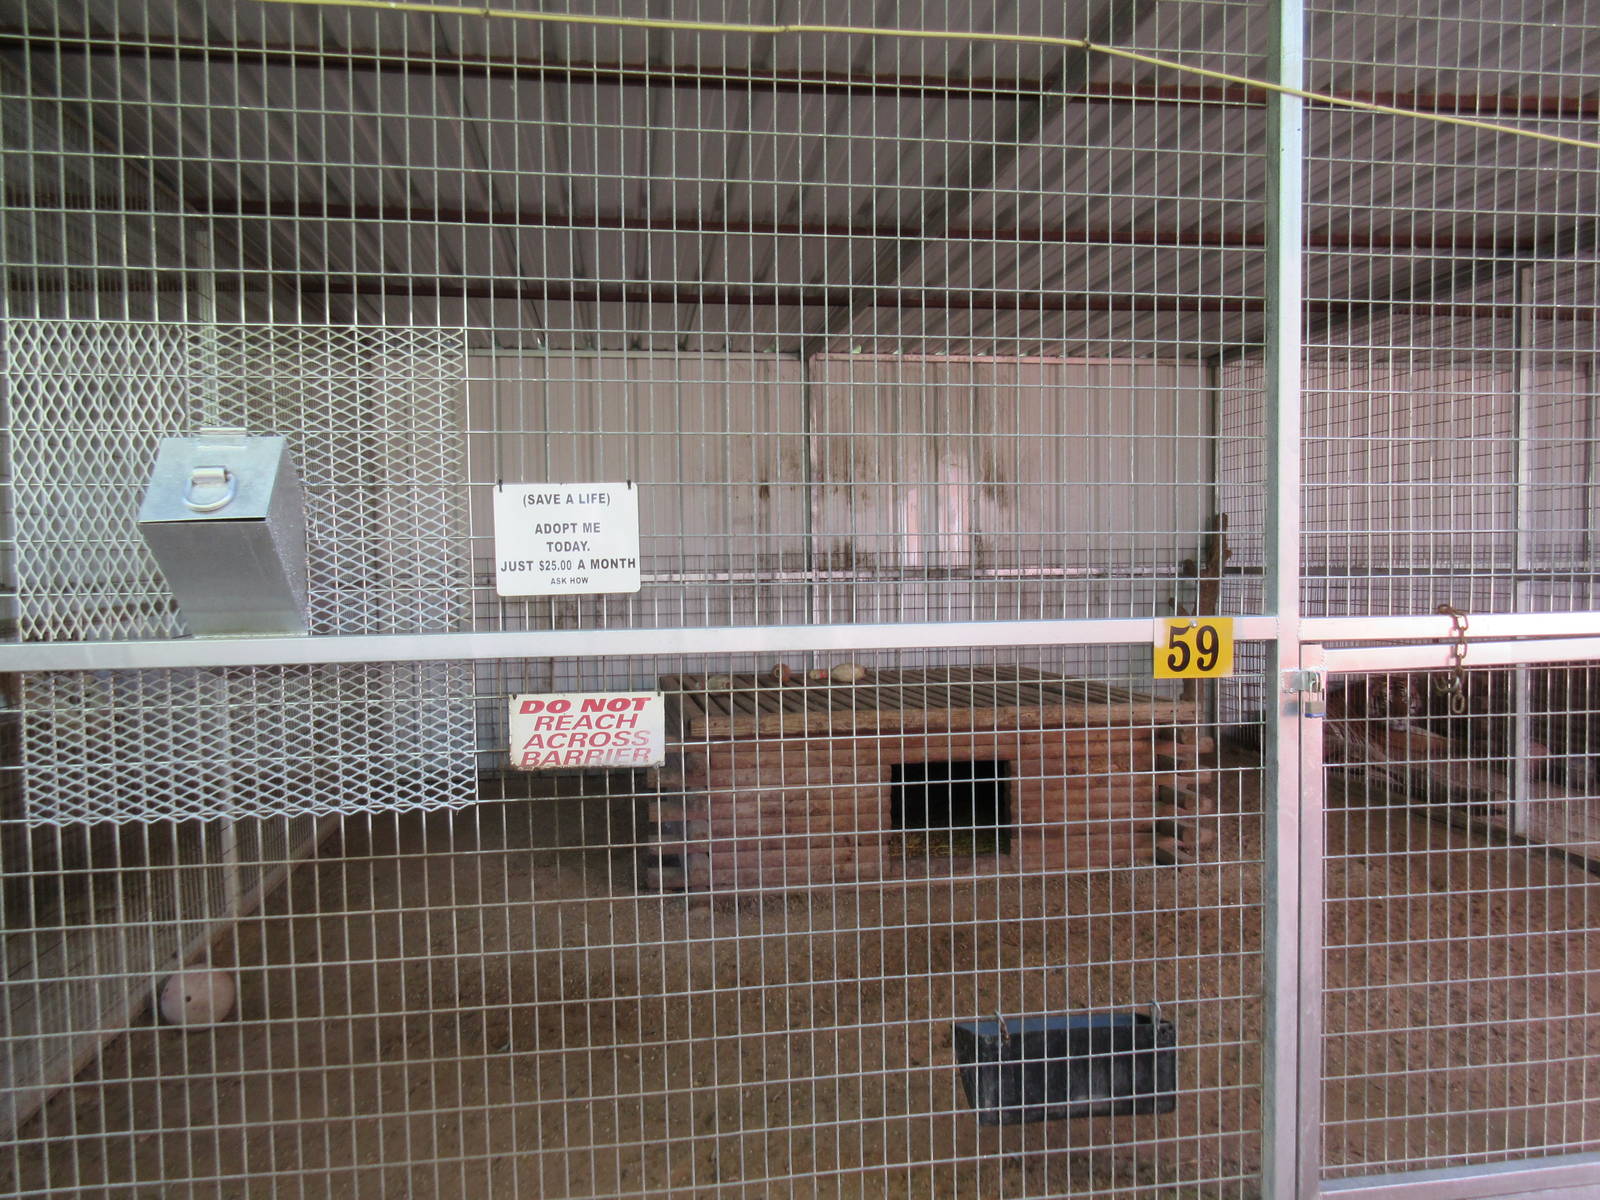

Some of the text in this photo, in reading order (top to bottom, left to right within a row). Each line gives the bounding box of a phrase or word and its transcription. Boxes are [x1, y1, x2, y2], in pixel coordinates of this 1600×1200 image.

[523, 492, 611, 508] (SAVE A LIFE)
[534, 522, 601, 535] ADOPT ME
[546, 541, 590, 552] TODAY.
[500, 558, 636, 572] JUST $25.00 A MONTH
[550, 577, 589, 585] ASK HOW
[1167, 625, 1219, 672] 59
[519, 697, 652, 715] DO NOT
[534, 713, 639, 731] REACH
[522, 730, 651, 750] ACROSS
[520, 747, 652, 767] BARRIER
